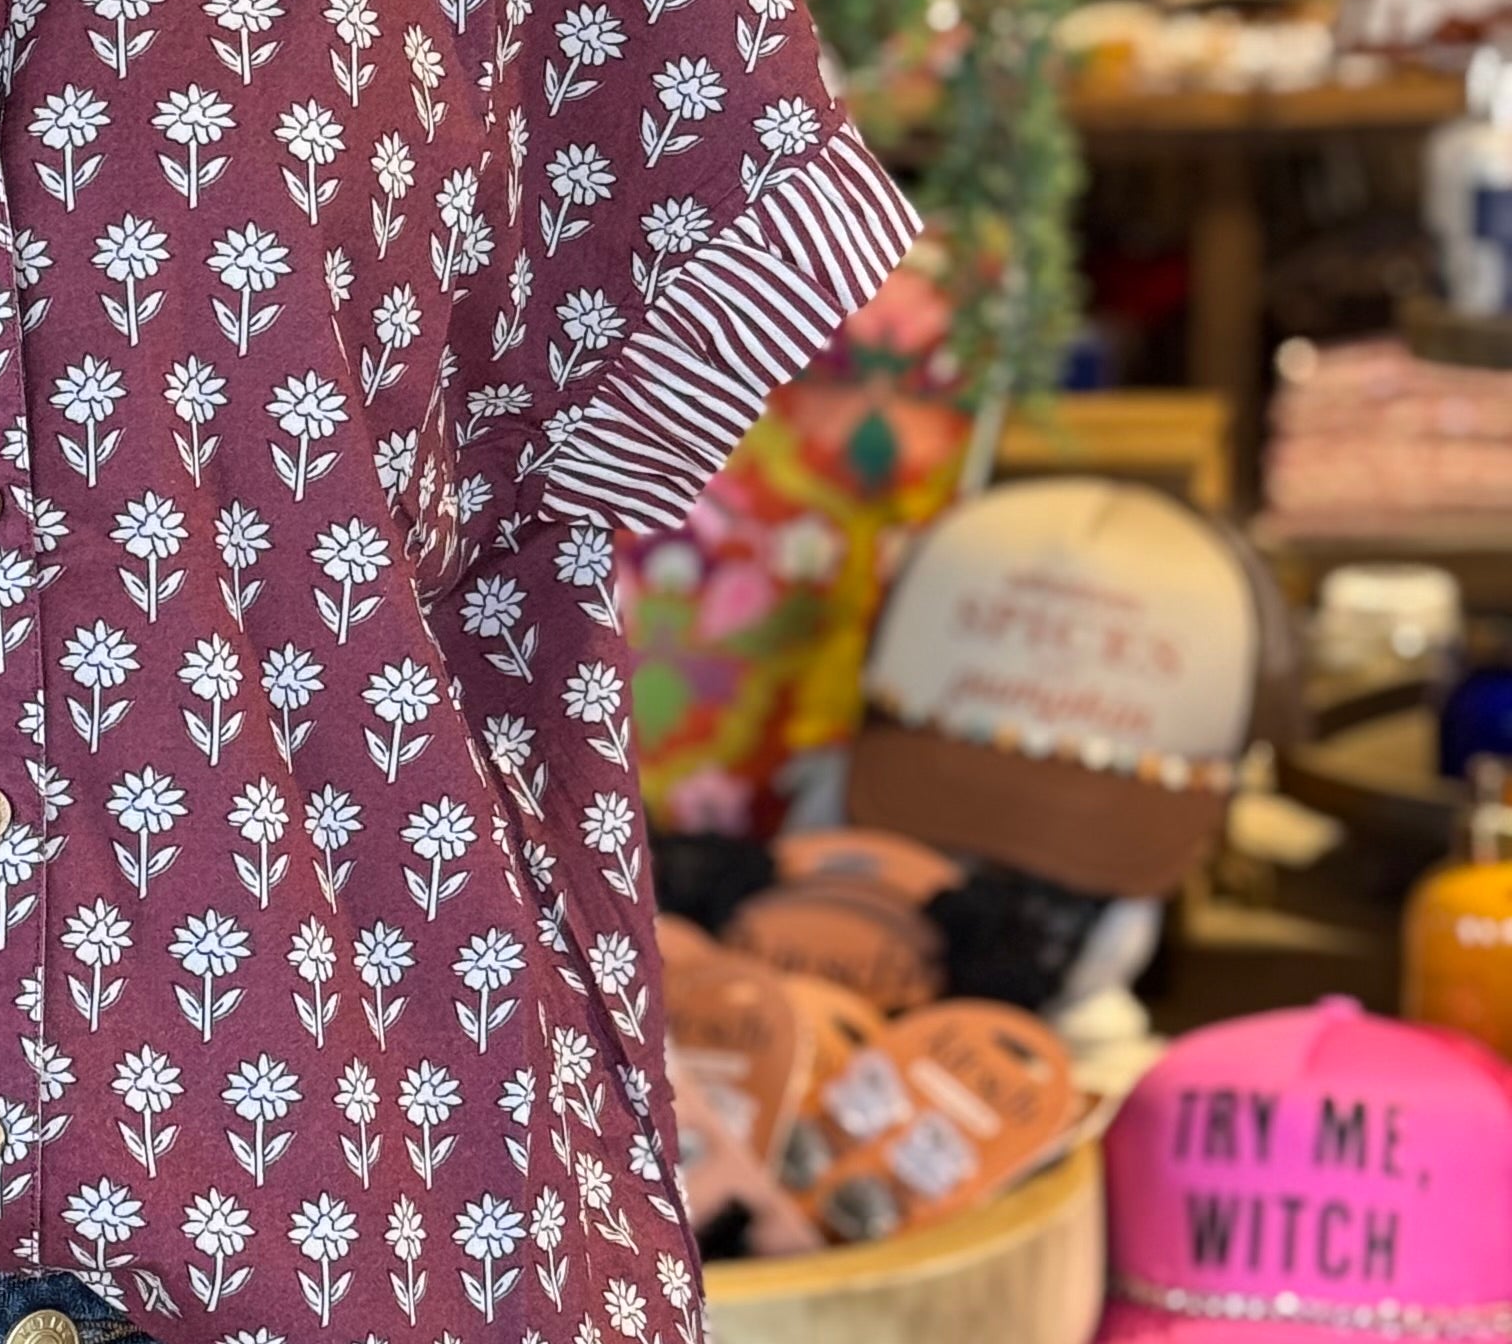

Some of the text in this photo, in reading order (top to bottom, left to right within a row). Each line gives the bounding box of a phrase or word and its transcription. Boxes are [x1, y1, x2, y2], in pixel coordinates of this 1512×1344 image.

[1174, 1090, 1431, 1191] TRY ME,
[1187, 1191, 1400, 1283] WITCH
